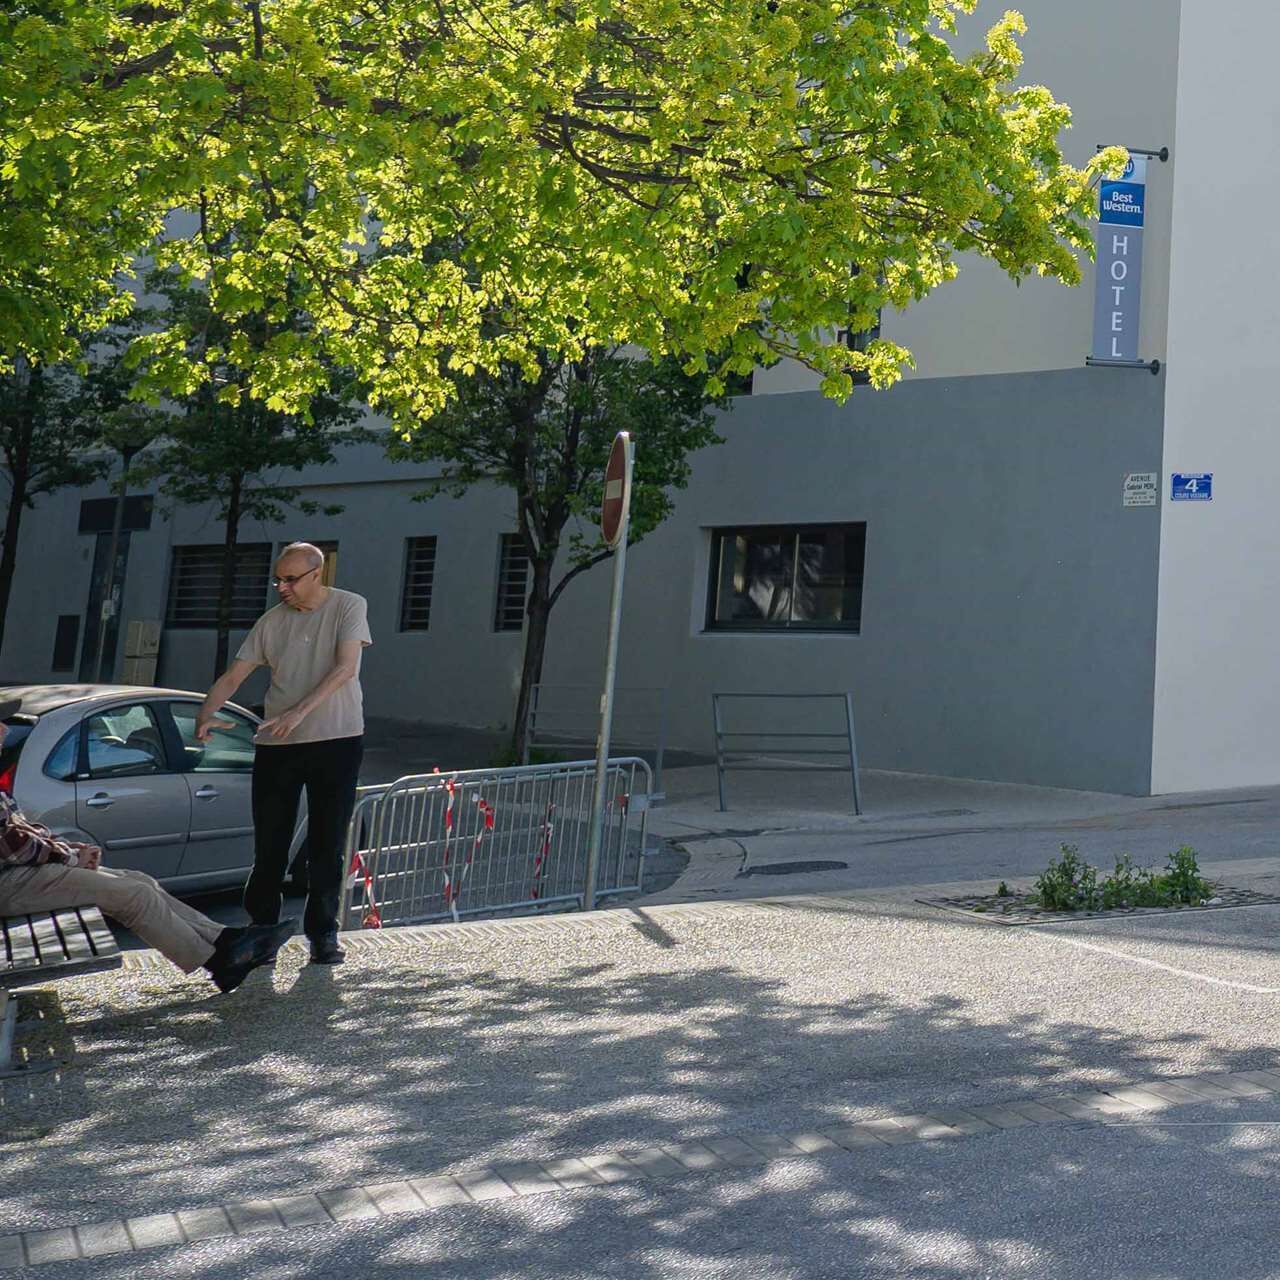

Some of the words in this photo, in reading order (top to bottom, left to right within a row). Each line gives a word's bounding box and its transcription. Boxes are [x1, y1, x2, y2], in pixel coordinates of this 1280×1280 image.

[1112, 191, 1134, 203] Best
[1110, 234, 1128, 358] HOTEL
[1184, 479, 1199, 493] 4
